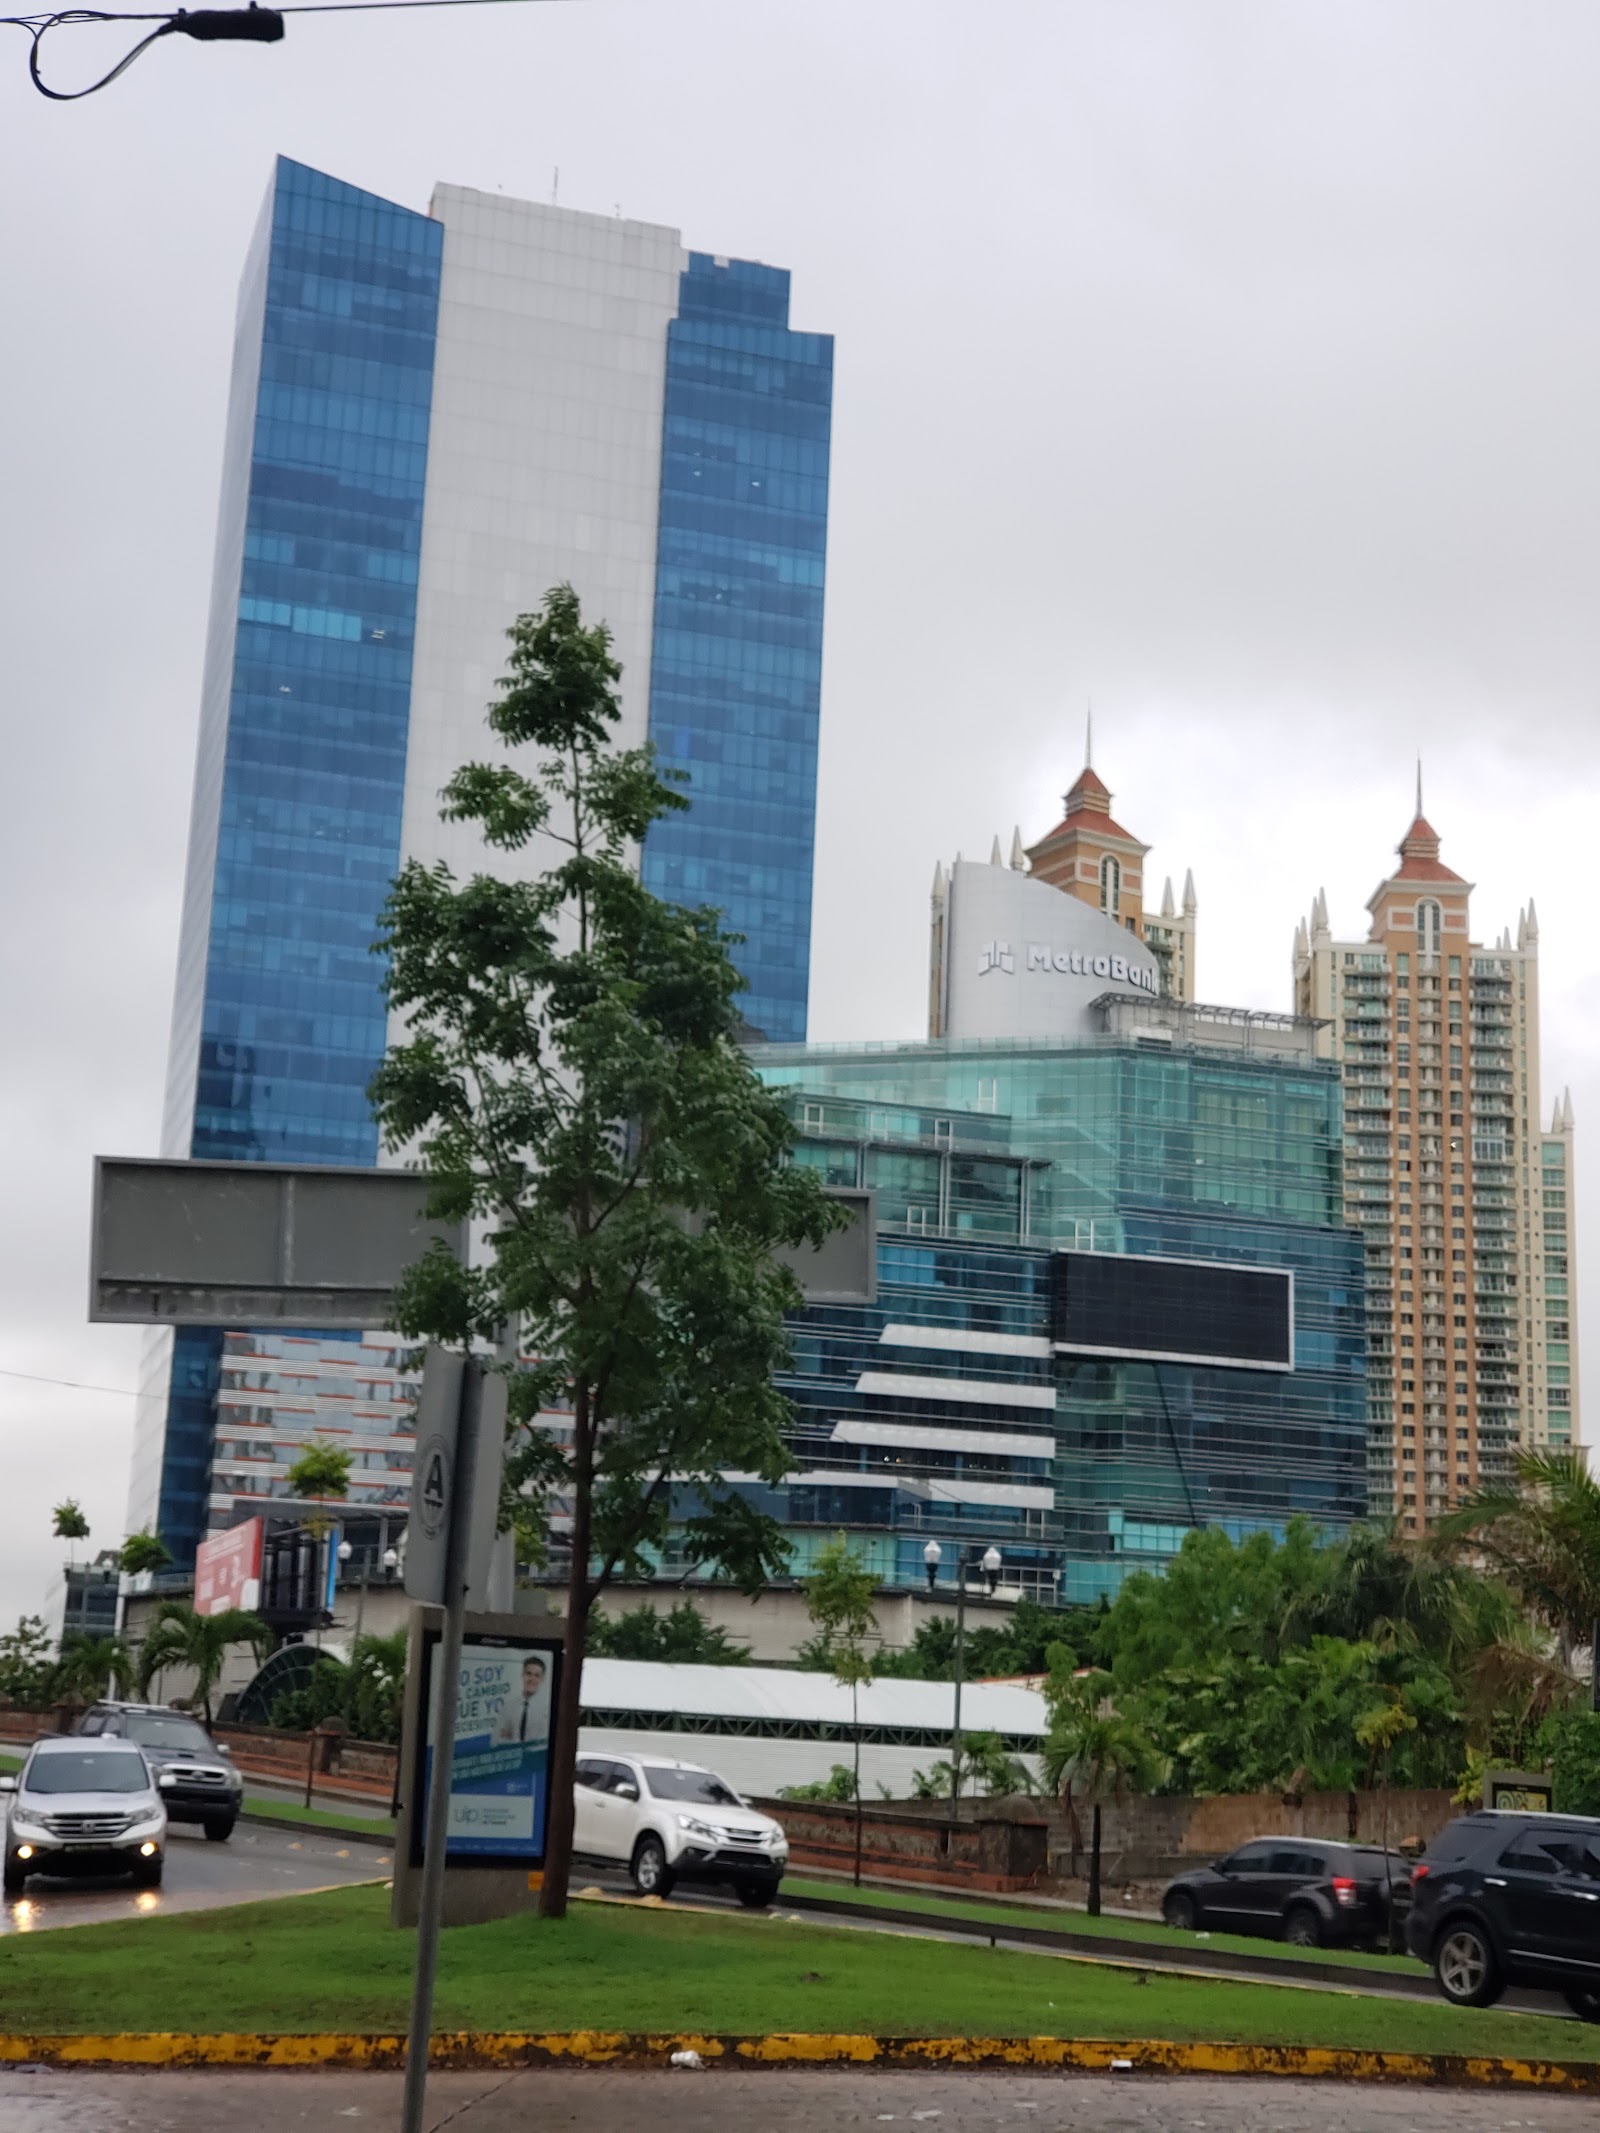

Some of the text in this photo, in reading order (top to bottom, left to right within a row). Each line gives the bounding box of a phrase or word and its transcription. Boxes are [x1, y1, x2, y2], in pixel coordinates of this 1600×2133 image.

[1027, 942, 1159, 996] MetroBank
[474, 1664, 504, 1685] SOY
[466, 1682, 511, 1699] CAMBIO
[459, 1700, 479, 1718] UE
